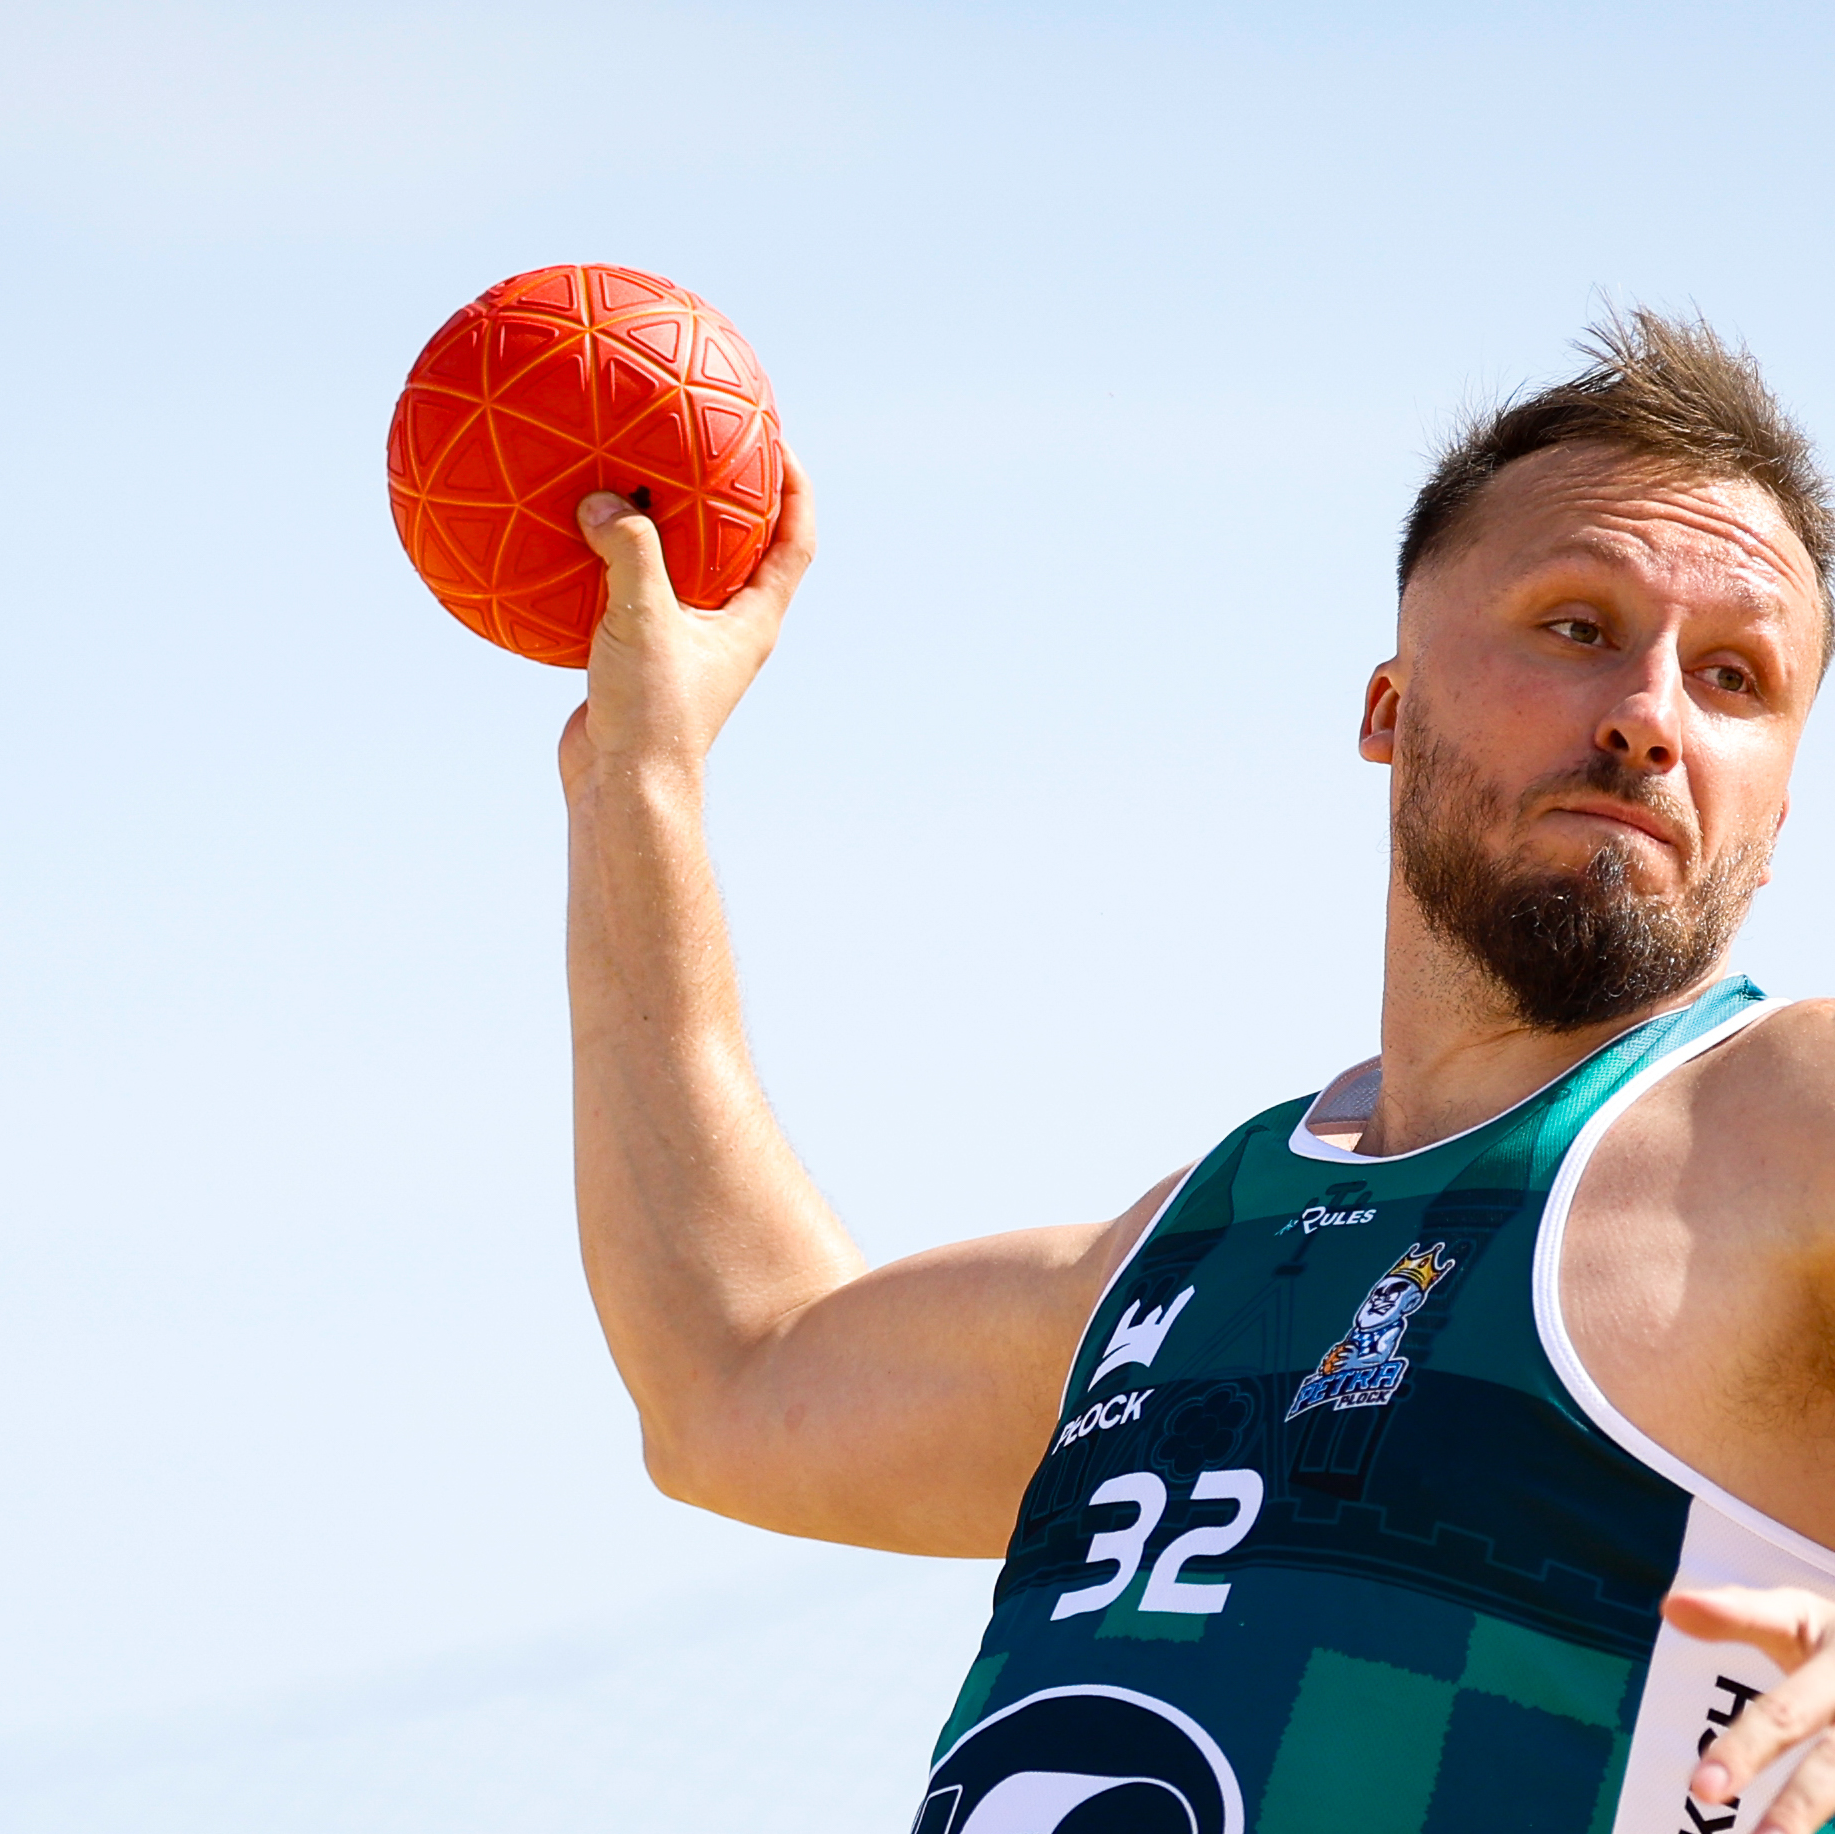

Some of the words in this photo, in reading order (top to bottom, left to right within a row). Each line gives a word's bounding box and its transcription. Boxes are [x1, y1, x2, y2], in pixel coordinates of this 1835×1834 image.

[1301, 1206, 1377, 1235] RULES
[1290, 1360, 1404, 1415] PETRA
[1050, 1469, 1264, 1621] 32
